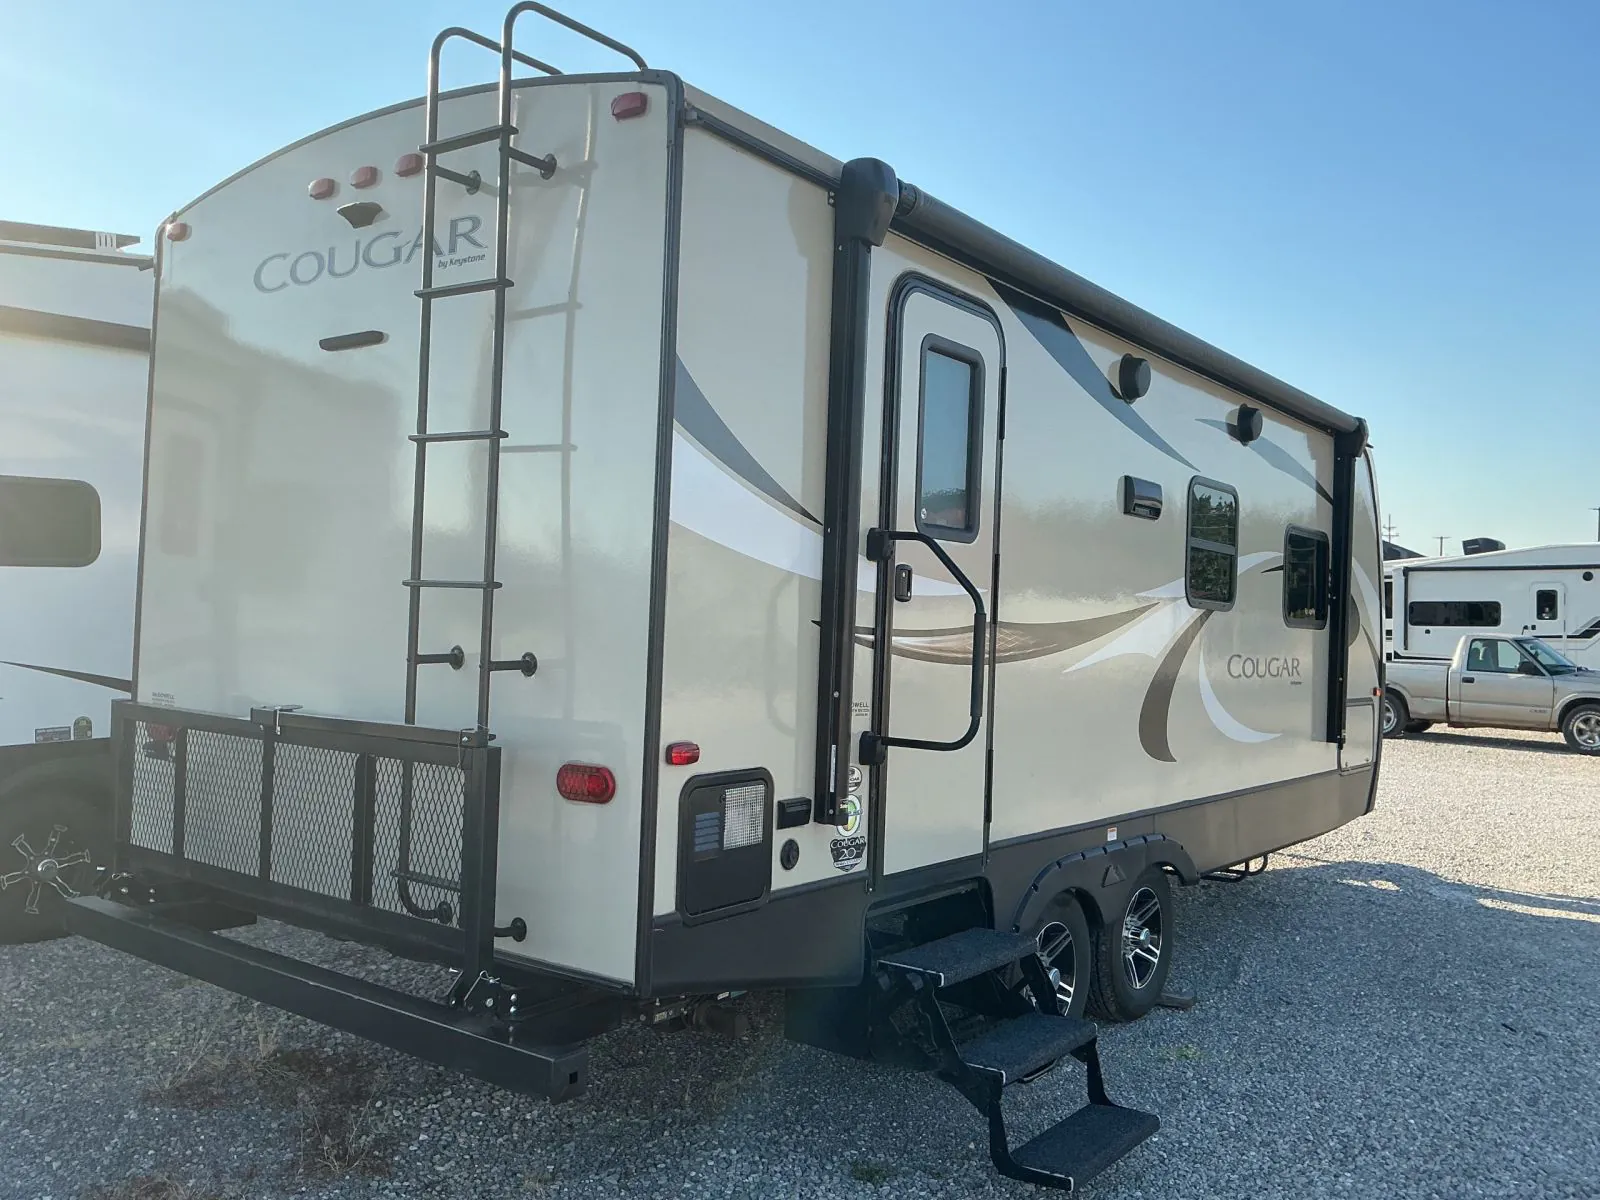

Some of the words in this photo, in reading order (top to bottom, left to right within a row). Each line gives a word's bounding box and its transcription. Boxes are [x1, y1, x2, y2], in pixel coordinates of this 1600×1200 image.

[253, 214, 488, 294] COUGAR
[438, 259, 448, 269] by
[449, 253, 486, 267] Keystone
[1227, 654, 1301, 679] COUGAR
[830, 837, 866, 849] COUGAR
[838, 847, 857, 860] 20
